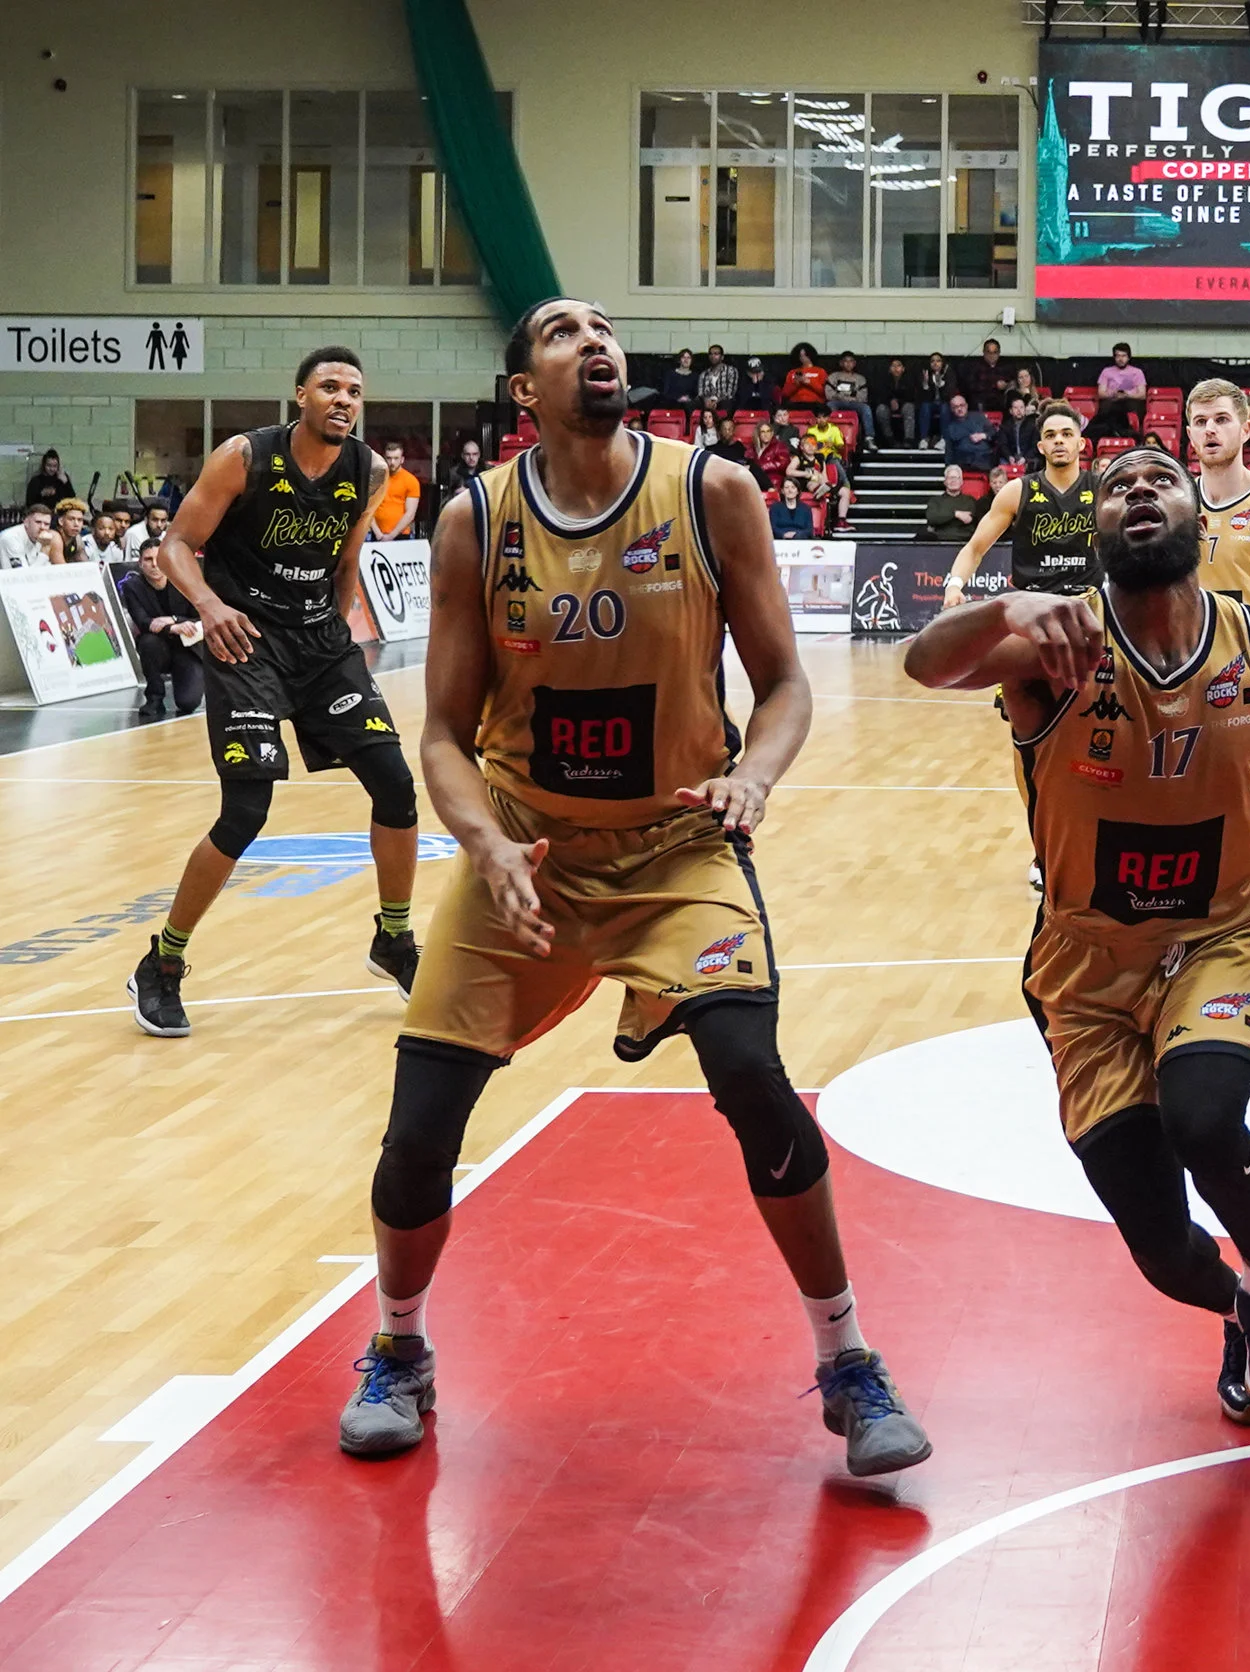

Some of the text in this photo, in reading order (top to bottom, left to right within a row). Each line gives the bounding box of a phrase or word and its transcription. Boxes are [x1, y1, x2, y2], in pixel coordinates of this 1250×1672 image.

[1068, 144, 1233, 159] PERFECTLY
[1068, 184, 1080, 201] A
[1094, 184, 1163, 202] TASTE
[1177, 185, 1204, 203] OF
[1171, 206, 1241, 223] SINCE
[7, 327, 122, 364] Toilets
[623, 551, 658, 567] ROCKS
[1040, 554, 1087, 567] Jelson
[395, 561, 430, 587] PETER
[551, 588, 627, 644] 20
[1206, 684, 1238, 702] ROCKS
[551, 717, 632, 759] RED
[1148, 725, 1204, 779] 17
[1117, 851, 1200, 892] RED
[697, 955, 730, 973] ROCKS
[1201, 1005, 1240, 1017] ROCKS
